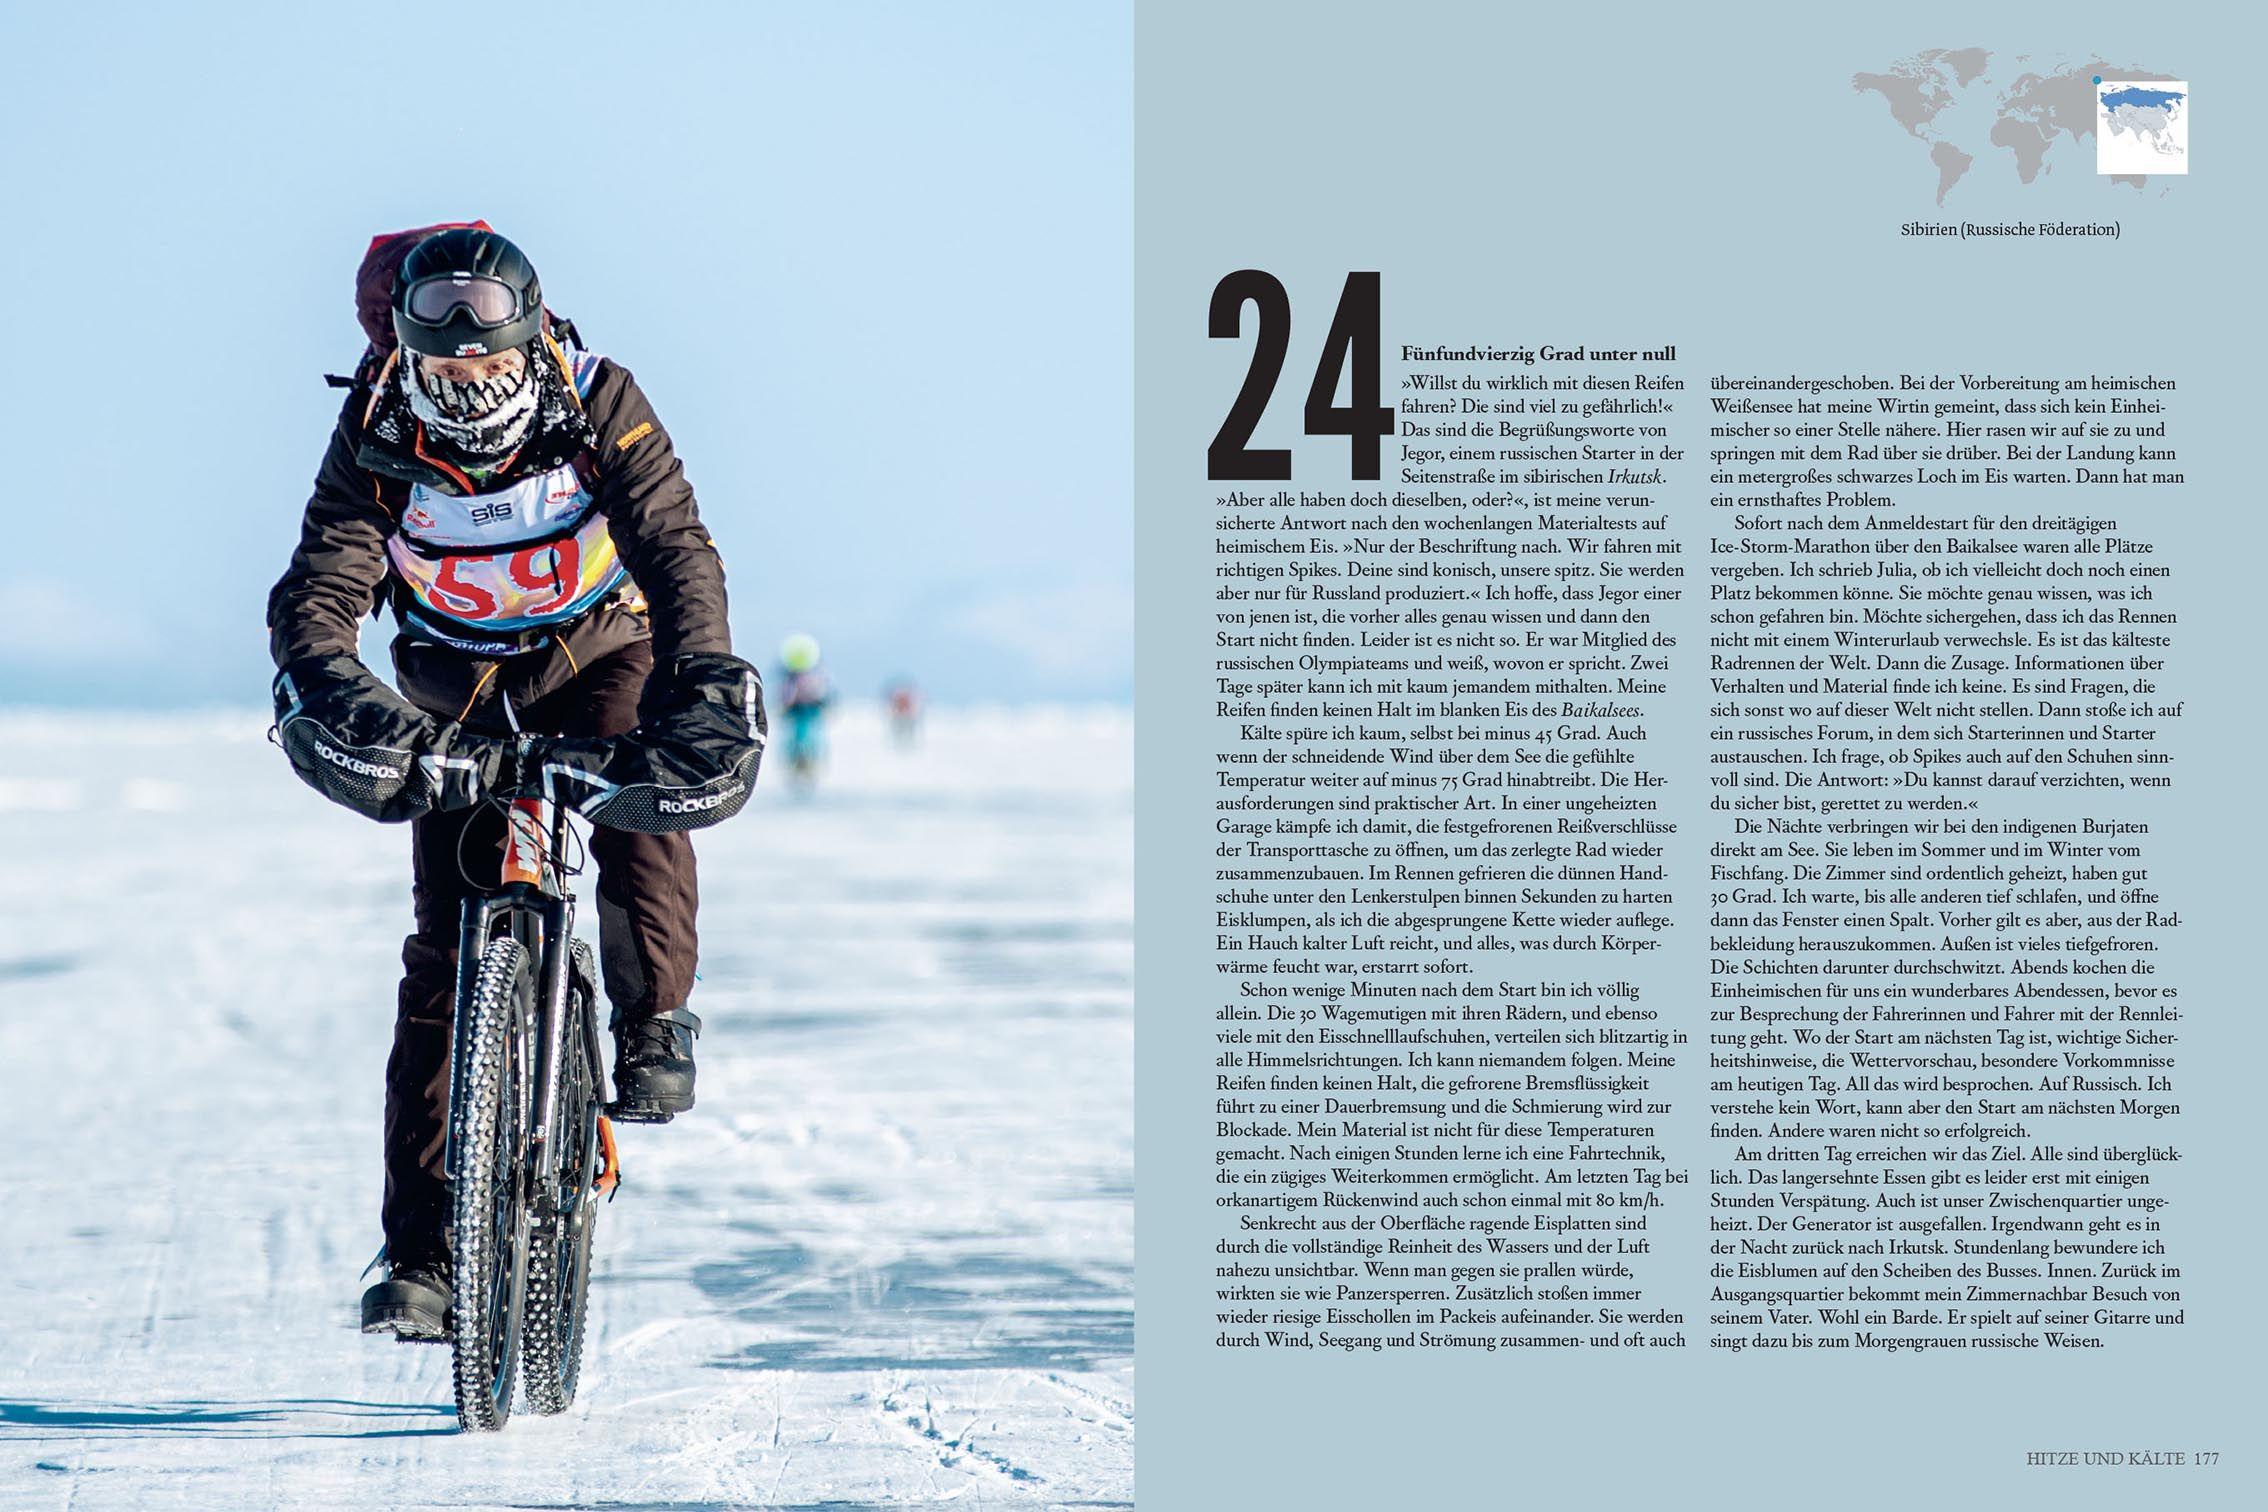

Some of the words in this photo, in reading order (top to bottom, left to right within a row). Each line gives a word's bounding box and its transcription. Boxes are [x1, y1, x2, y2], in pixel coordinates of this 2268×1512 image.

[1900, 221, 1958, 236] Sibirien
[1960, 220, 2036, 241] (Russische
[2038, 220, 2121, 241] Föderation)
[1400, 345, 1536, 366] Fünfundvierzig
[1539, 345, 1586, 361] Grad
[1589, 349, 1639, 361] unter
[1641, 344, 1677, 361] null
[1207, 269, 1395, 481] 24
[1401, 374, 1458, 391] »Willst
[1461, 374, 1482, 391] du
[1485, 374, 1549, 391] wirklich
[1552, 375, 1579, 391] mit
[1582, 374, 1631, 391] diesen
[1634, 374, 1685, 391] Reifen
[1710, 374, 1894, 396] übereinandergeschoben.
[1899, 374, 1926, 391] Bei
[1929, 374, 1956, 391] der
[1959, 374, 2060, 396] Vorbereitung
[2064, 380, 2088, 391] am
[2090, 374, 2177, 391] heimischen
[1400, 467, 1496, 484] Seitenstraße
[1499, 468, 1520, 484] im
[1523, 467, 1604, 484] sibirischen
[1607, 467, 1667, 485] Irkutsk.
[1216, 491, 1266, 507] »Aber
[1269, 491, 1296, 507] alle
[1299, 491, 1347, 507] haben
[1350, 491, 1388, 507] doch
[1391, 491, 1467, 510] dieselben,
[1471, 491, 1529, 510] oder?«,
[1533, 492, 1552, 507] ist
[1556, 492, 1602, 507] meine
[1605, 496, 1656, 507] verun-
[1215, 537, 1306, 554] heimischem
[1309, 537, 1339, 554] Eis.
[1343, 537, 1386, 554] »Nur
[1389, 537, 1416, 554] der
[1418, 537, 1518, 559] Beschriftung
[1520, 537, 1562, 554] nach.
[1566, 537, 1600, 554] Wir
[1603, 537, 1653, 554] fahren
[1655, 538, 1683, 554] mit
[1710, 537, 1871, 554] Ice-Storm-Marathon
[1874, 537, 1910, 554] über
[1913, 537, 1943, 554] den
[1945, 537, 2019, 554] Baikalsee
[2022, 543, 2070, 554] waren
[2073, 537, 2101, 554] alle
[2104, 537, 2154, 554] Plätze
[428, 538, 580, 620] 59
[1710, 654, 1796, 671] Radrennen
[1799, 654, 1825, 671] der
[1828, 654, 1871, 671] Welt.
[1876, 654, 1920, 671] Dann
[1923, 654, 1947, 671] die
[1951, 654, 2010, 676] Zusage.
[2014, 654, 2125, 671] Informationen
[2129, 654, 2165, 671] über
[1215, 700, 1267, 717] Reifen
[1270, 700, 1319, 717] finden
[1322, 701, 1373, 717] keinen
[1376, 700, 1412, 717] Halt
[1416, 702, 1436, 717] im
[1439, 701, 1501, 717] blanken
[1504, 700, 1529, 717] Eis
[1531, 701, 1558, 717] des
[1560, 701, 1645, 718] Baikalsees.
[1710, 725, 1734, 741] ein
[1737, 724, 1814, 741] russisches
[1816, 724, 1874, 744] Forum,
[1877, 725, 1893, 741] in
[1896, 724, 1930, 741] dem
[1933, 724, 1964, 741] sich
[1967, 724, 2065, 741] Starterinnen
[2068, 724, 2098, 741] und
[2101, 724, 2157, 741] Starter
[314, 740, 400, 779] ROCKBROS
[1216, 770, 1306, 792] Temperatur
[1309, 772, 1360, 787] weiter
[1362, 771, 1391, 787] auf
[1390, 772, 1438, 787] minus
[1441, 776, 1458, 792] 75
[1462, 770, 1503, 787] Grad
[1506, 771, 1596, 787] hinabtreibt.
[1600, 770, 1629, 787] Die
[1633, 770, 1669, 787] Her-
[659, 782, 745, 814] ROCKBROS
[1710, 892, 1729, 909] 30
[1732, 887, 1777, 904] Grad.
[1782, 887, 1807, 904] Ich
[1810, 892, 1860, 907] warte,
[1864, 888, 1886, 904] bis
[1889, 887, 1917, 904] alle
[1920, 887, 1983, 904] anderen
[1985, 887, 2014, 904] tief
[2015, 887, 2083, 907] schlafen,
[2087, 887, 2117, 904] und
[2120, 887, 2160, 904] öffne
[1215, 1004, 1262, 1021] allein.
[1266, 1004, 1296, 1021] Die
[1299, 1009, 1317, 1025] 30
[1320, 1004, 1427, 1026] Wagemutigen
[1431, 1005, 1457, 1021] mit
[1462, 1004, 1502, 1021] ihren
[1505, 1004, 1568, 1024] Rädern,
[1570, 1004, 1602, 1021] und
[1605, 1004, 1658, 1021] ebenso
[1709, 1168, 1743, 1185] lich.
[1747, 1168, 1779, 1185] Das
[1781, 1168, 1879, 1190] langersehnte
[1882, 1168, 1927, 1185] Essen
[1930, 1168, 1961, 1190] gibt
[1965, 1174, 1981, 1185] es
[1983, 1168, 2028, 1185] leider
[2031, 1173, 2061, 1185] erst
[2065, 1169, 2092, 1185] mit
[2095, 1169, 2150, 1190] einigen
[1215, 1191, 1319, 1212] orkanartigem
[1322, 1191, 1419, 1208] Rückenwind
[1422, 1191, 1459, 1207] auch
[1462, 1191, 1508, 1207] schon
[1510, 1191, 1563, 1208] einmal
[1565, 1192, 1593, 1207] mit
[1595, 1192, 1615, 1207] 80
[1618, 1191, 1665, 1212] km/h.
[1215, 1331, 1261, 1348] durch
[1263, 1331, 1314, 1351] Wind,
[1318, 1331, 1383, 1353] Seegang
[1386, 1331, 1416, 1348] und
[1419, 1331, 1497, 1352] Strömung
[1500, 1336, 1585, 1348] zusammen-
[1589, 1331, 1620, 1348] und
[1623, 1331, 1646, 1348] oft
[1649, 1331, 1687, 1348] auch
[1710, 1333, 1748, 1353] singt
[1751, 1332, 1789, 1348] dazu
[1791, 1332, 1814, 1348] bis
[1817, 1337, 1850, 1348] zum
[1854, 1331, 1968, 1353] Morgengrauen
[1971, 1332, 2039, 1348] russische
[2043, 1331, 2105, 1348] Weisen.
[2026, 1451, 2080, 1466] HITZE
[2082, 1451, 2124, 1466] UND
[2127, 1449, 2186, 1466] KÄLTE
[2194, 1452, 2220, 1466] 177
